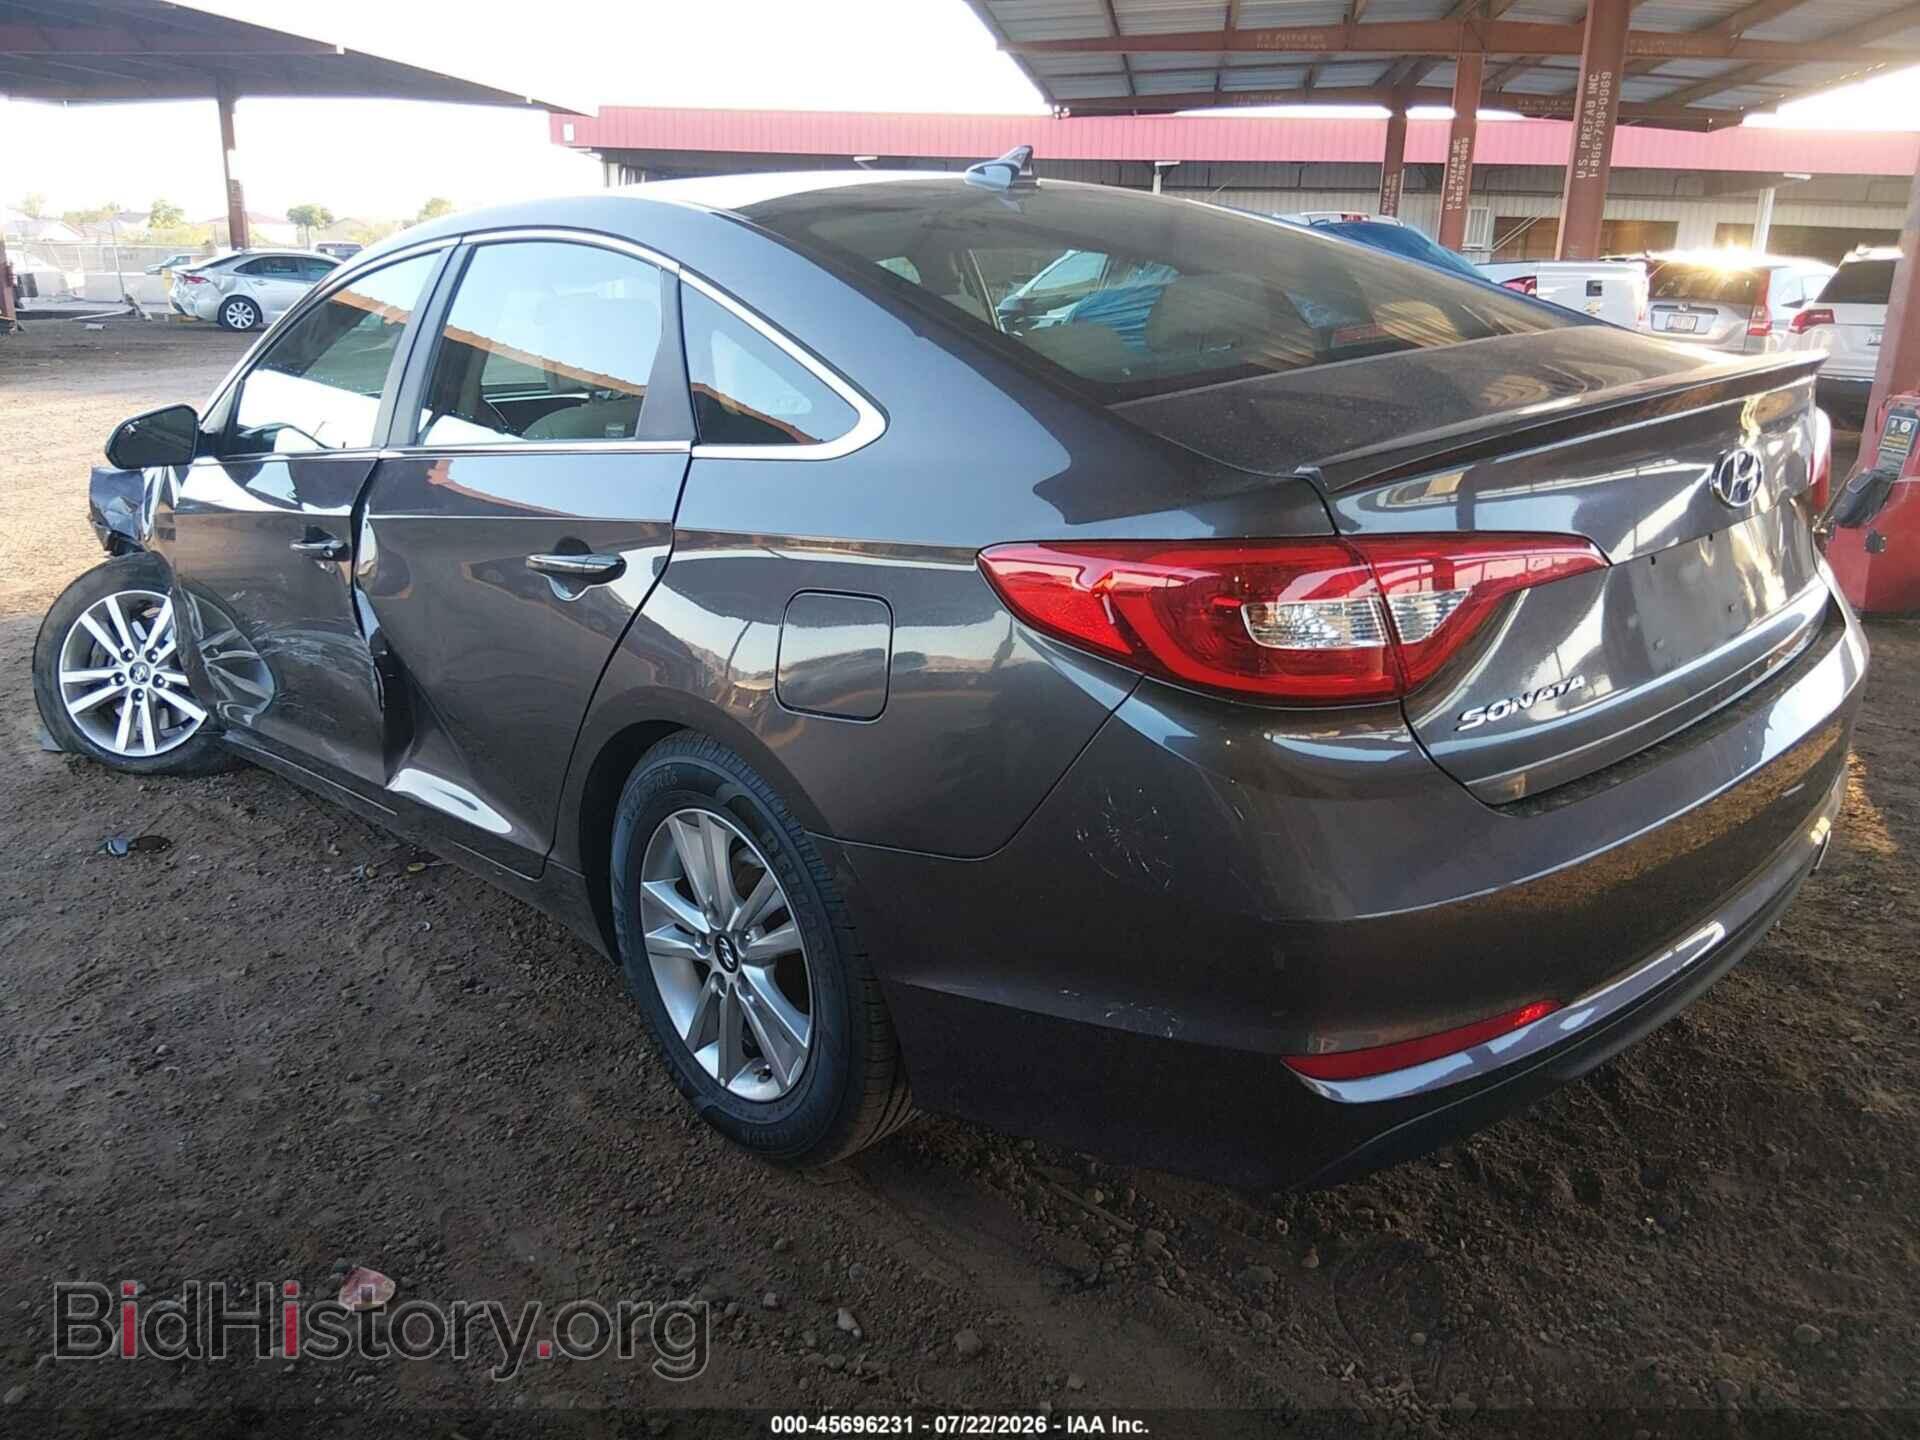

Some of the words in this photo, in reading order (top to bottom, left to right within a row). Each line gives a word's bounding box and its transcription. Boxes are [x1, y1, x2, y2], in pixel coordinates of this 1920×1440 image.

[1580, 100, 1597, 149] PREFAB
[1575, 155, 1590, 179] U.S.
[1454, 674, 1586, 732] SONATA
